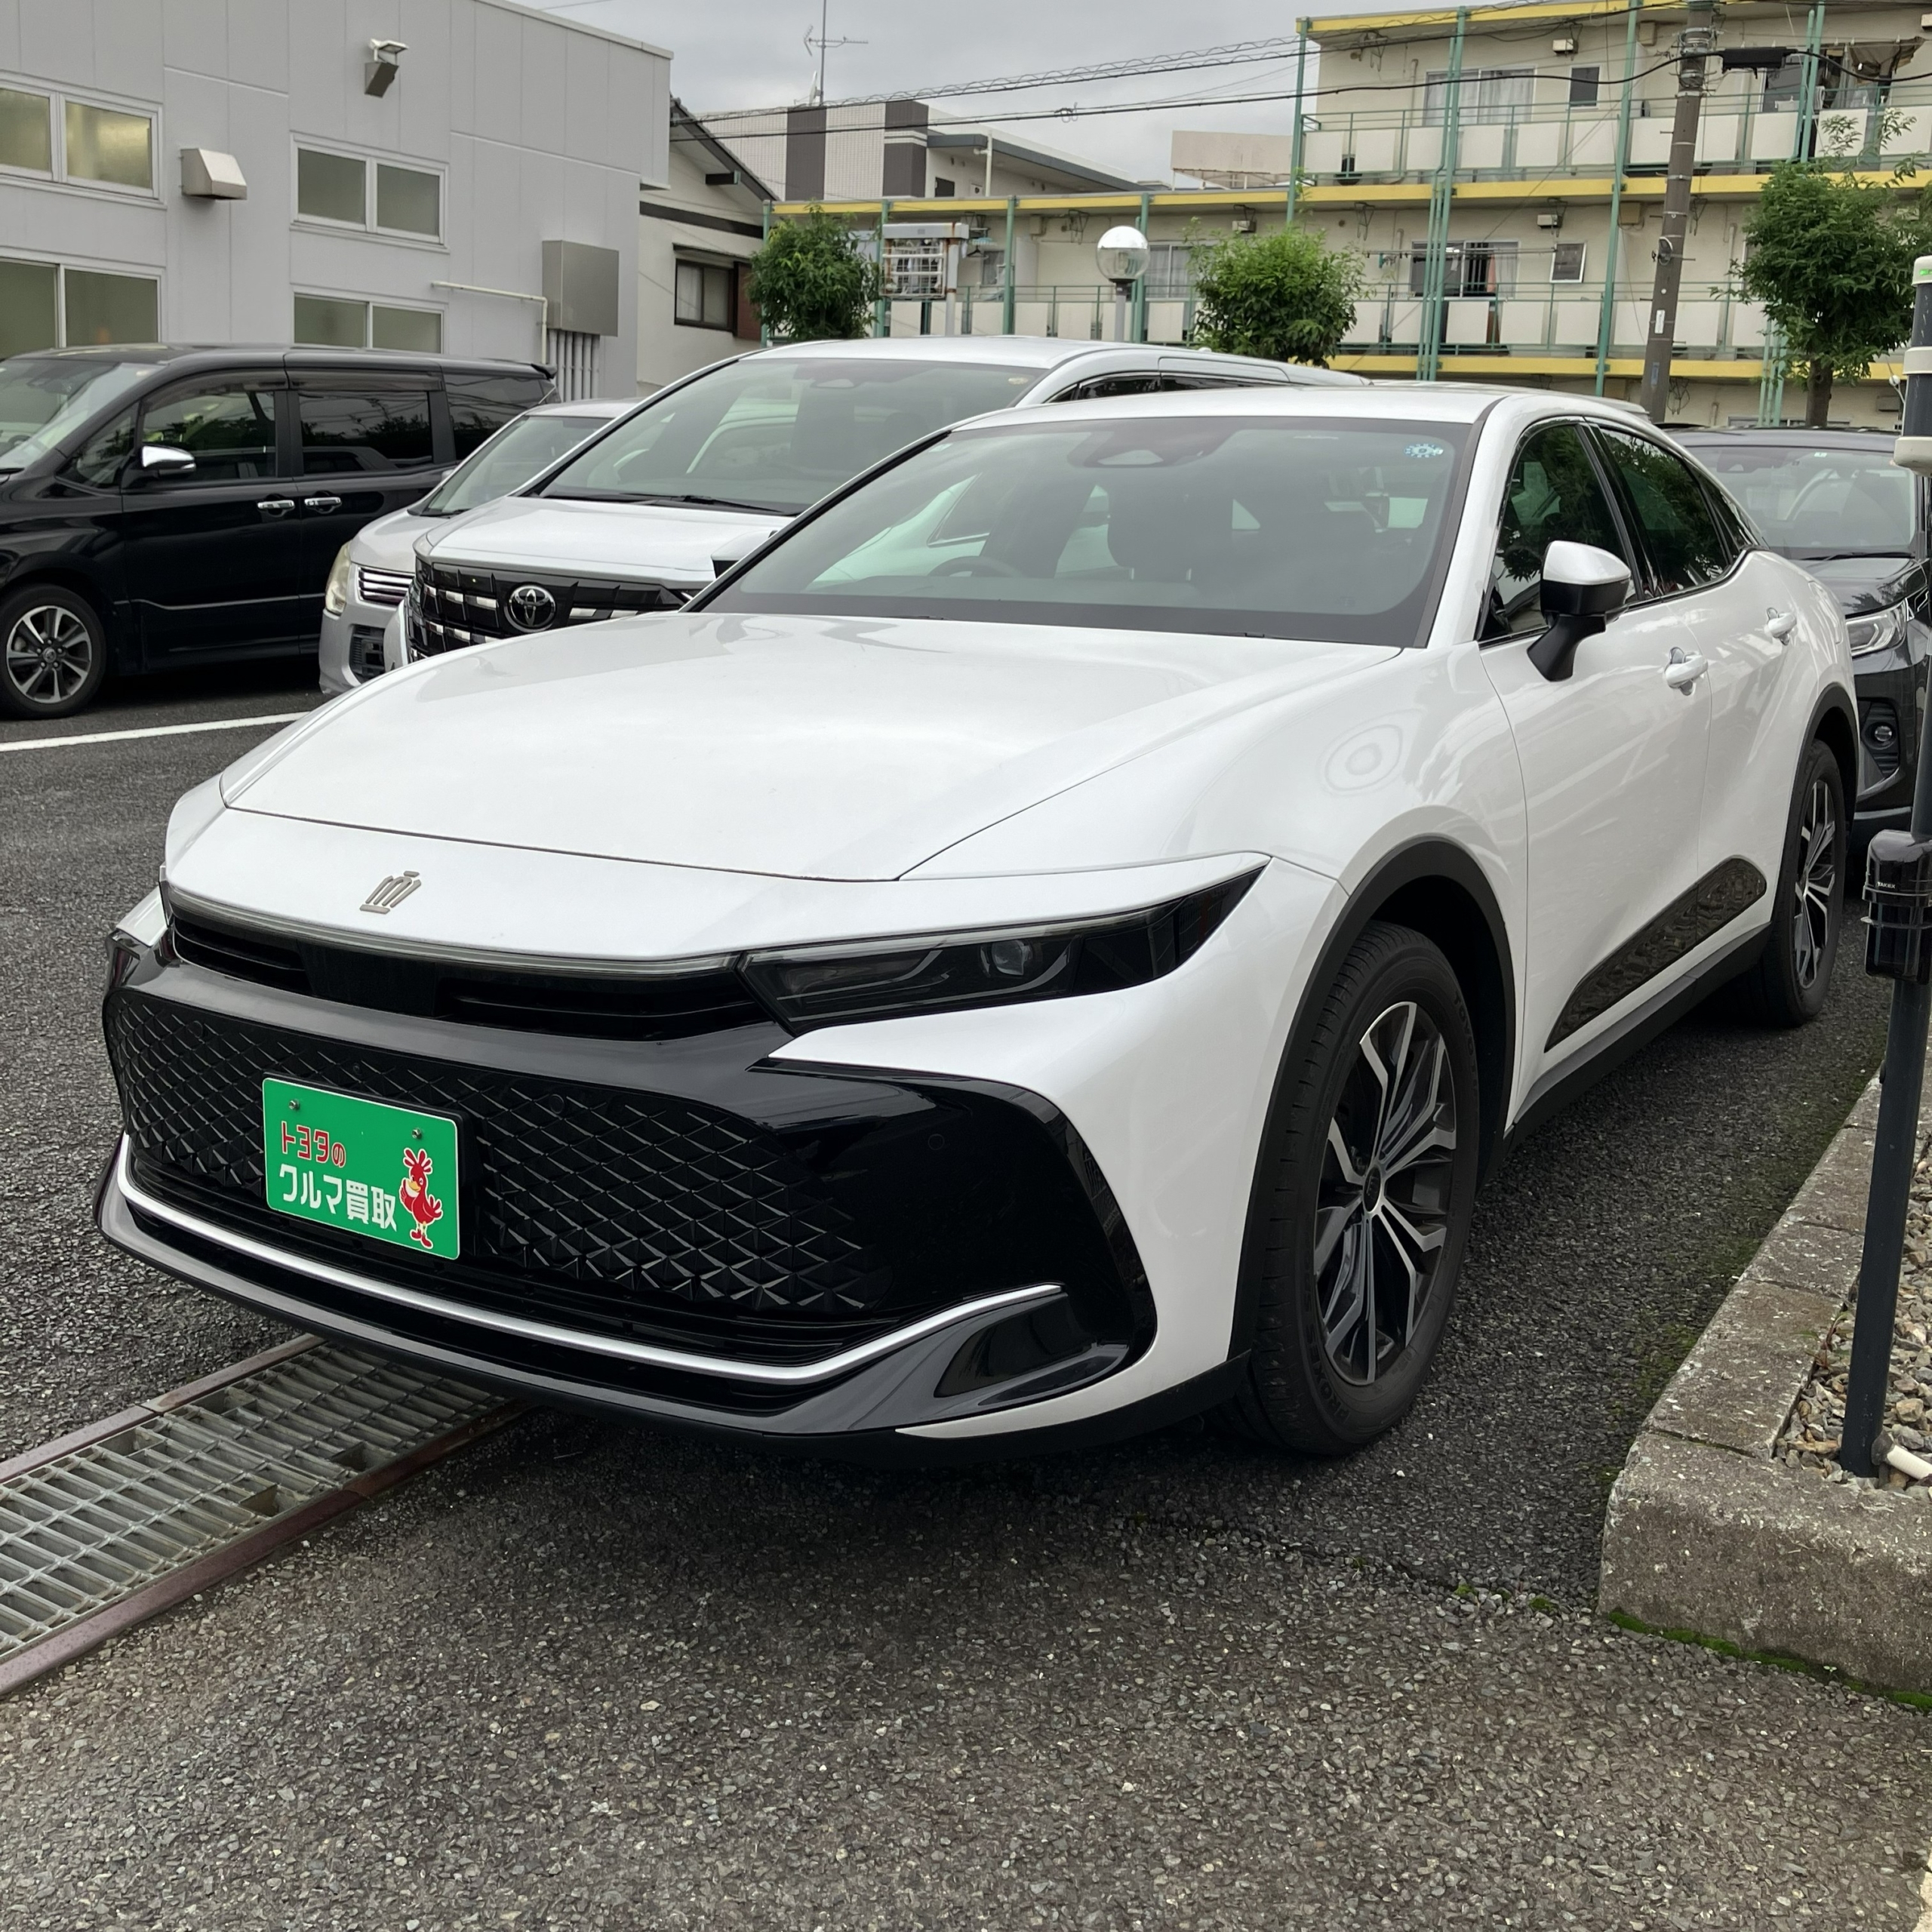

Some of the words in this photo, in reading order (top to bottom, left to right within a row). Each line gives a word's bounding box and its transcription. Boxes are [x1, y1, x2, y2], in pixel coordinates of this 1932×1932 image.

[1877, 881, 1896, 889] TAKEX
[281, 1121, 346, 1168] トヨタの
[279, 1164, 397, 1232] クルマ買取
